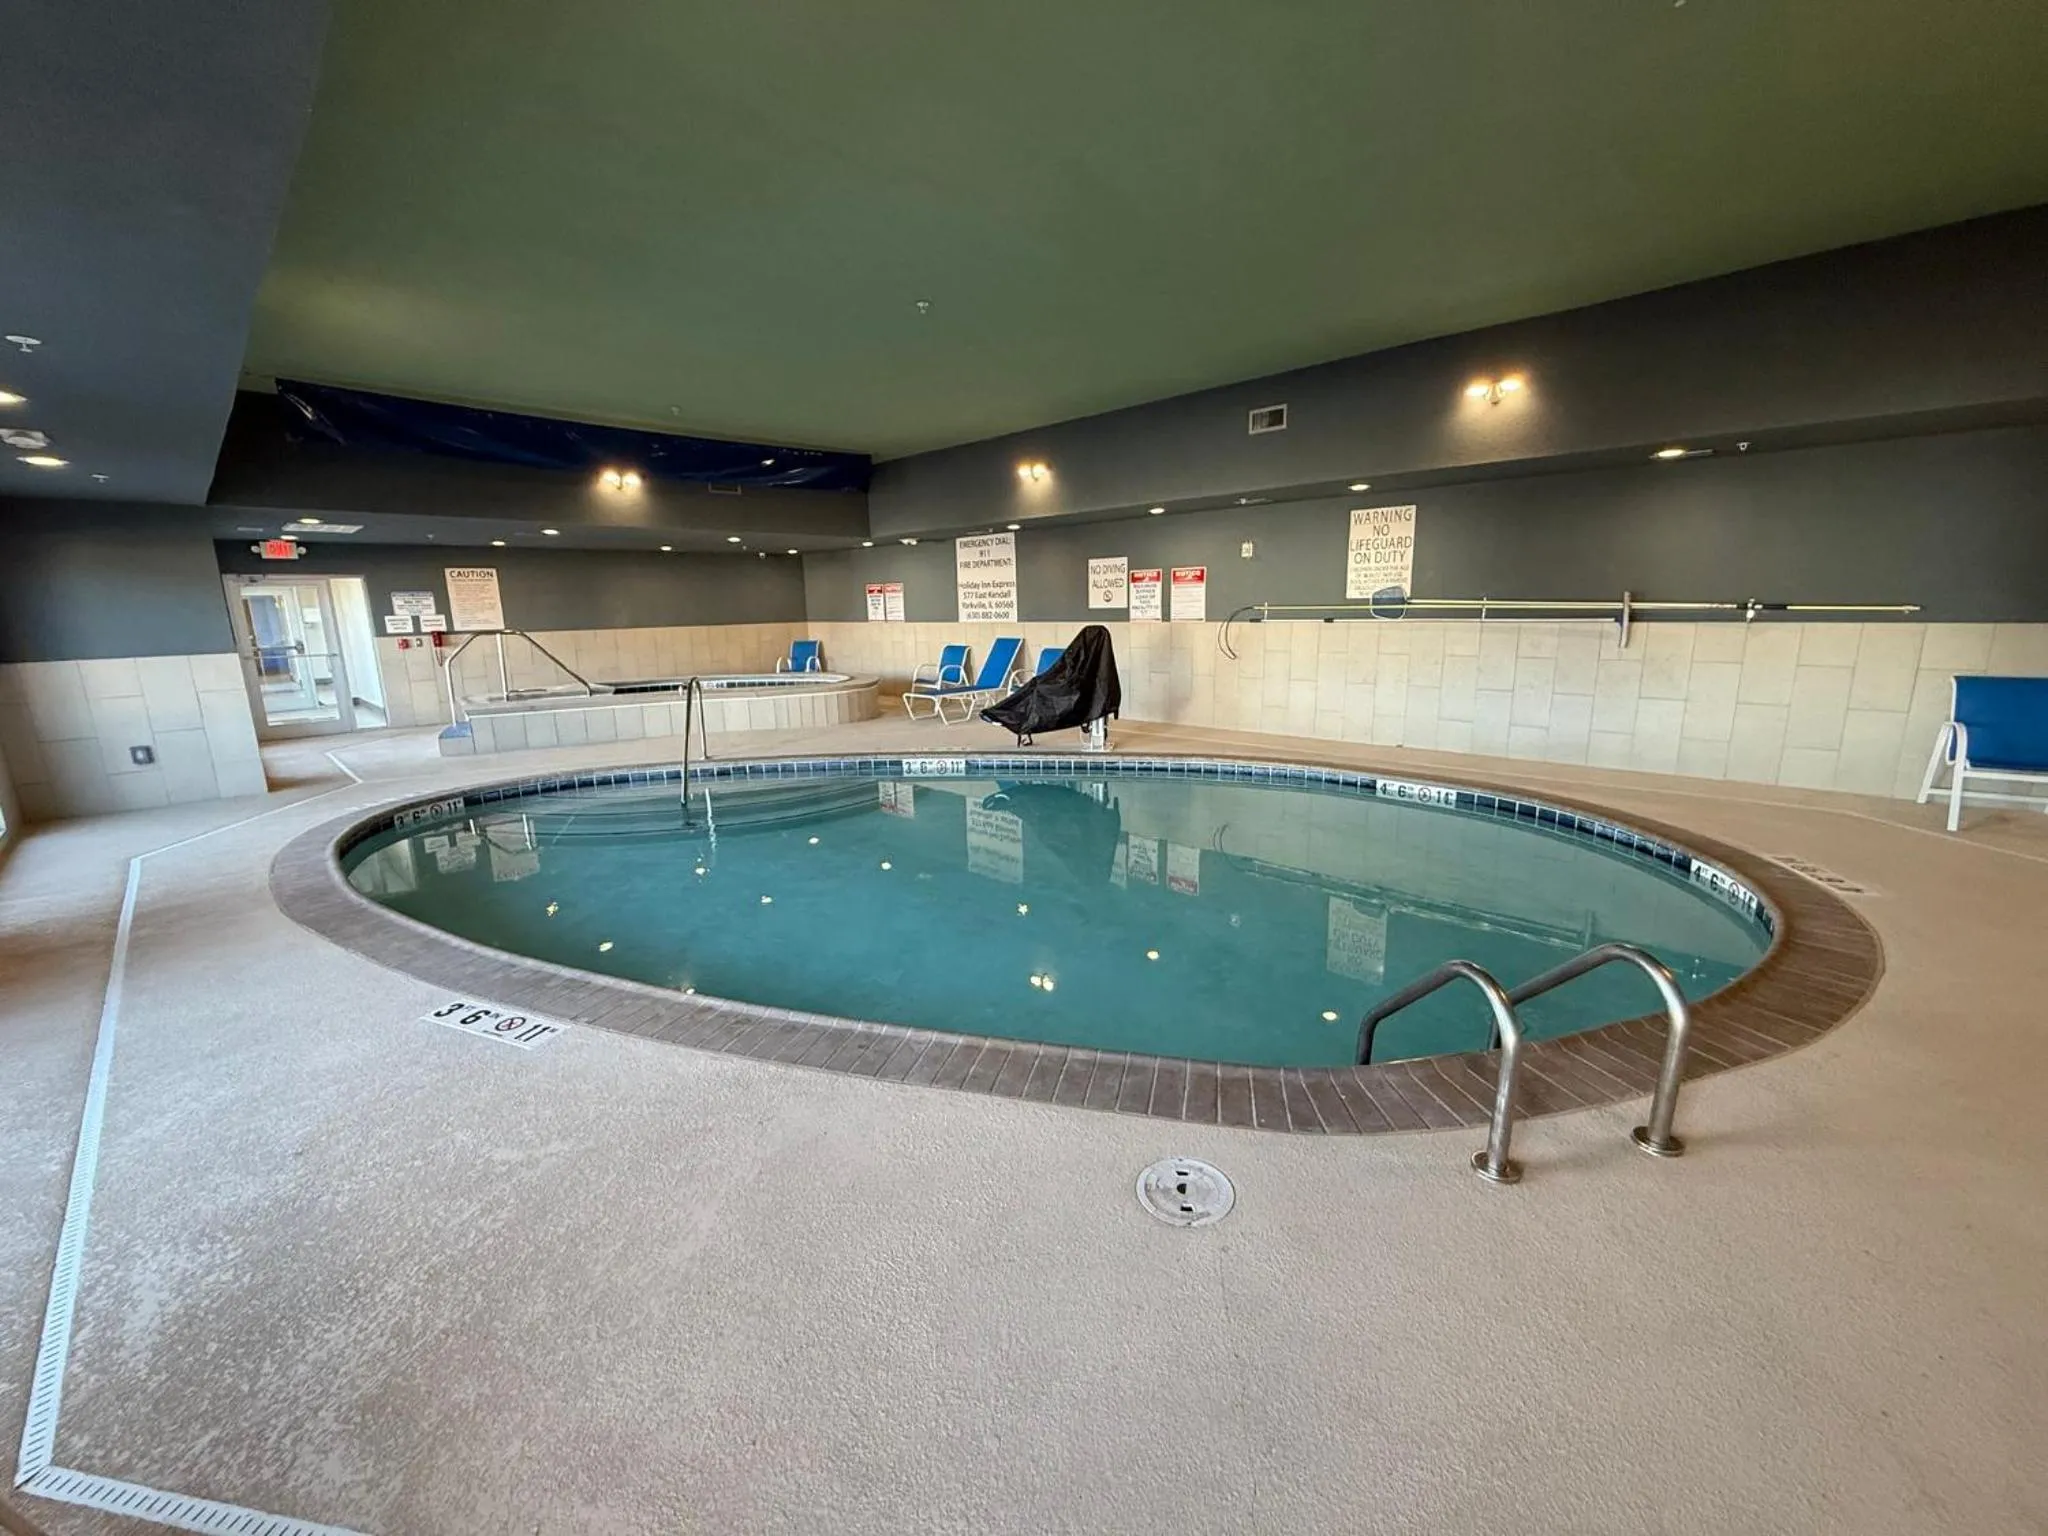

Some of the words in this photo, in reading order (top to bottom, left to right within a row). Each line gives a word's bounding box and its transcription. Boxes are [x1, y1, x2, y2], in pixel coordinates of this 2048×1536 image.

[1353, 508, 1413, 526] WARNING
[1373, 524, 1390, 537] NO
[960, 538, 994, 549] EMERGENCY
[1350, 535, 1413, 552] LIFEGUARD
[1354, 552, 1371, 564] ON
[1375, 550, 1406, 564] DUTY
[449, 570, 494, 579] CAUTION
[1090, 564, 1101, 576] NO
[1102, 563, 1126, 575] DIVING
[1092, 577, 1125, 590] ALLOWED
[433, 1003, 465, 1018] 3
[459, 1010, 491, 1025] 6
